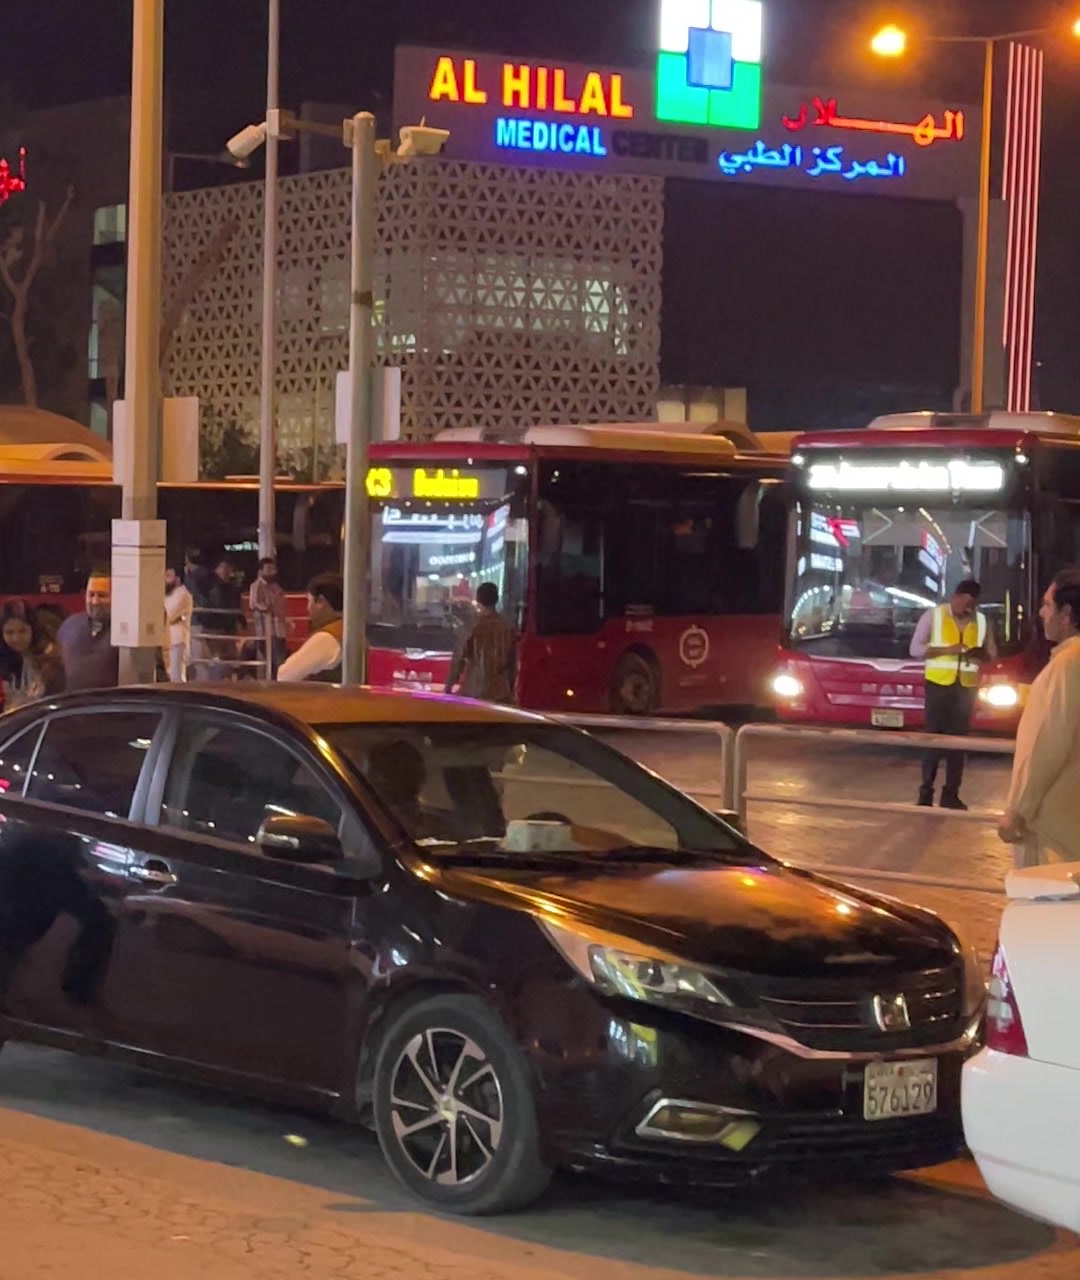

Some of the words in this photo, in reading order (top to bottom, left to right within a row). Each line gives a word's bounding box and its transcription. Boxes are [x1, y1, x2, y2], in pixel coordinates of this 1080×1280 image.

[428, 55, 487, 104] AL
[501, 63, 633, 118] HILAL
[495, 117, 607, 156] MEDICAL
[611, 129, 709, 163] CENTER
[782, 96, 965, 146] الهلال
[718, 139, 803, 175] الطبي
[806, 145, 905, 180] المركز
